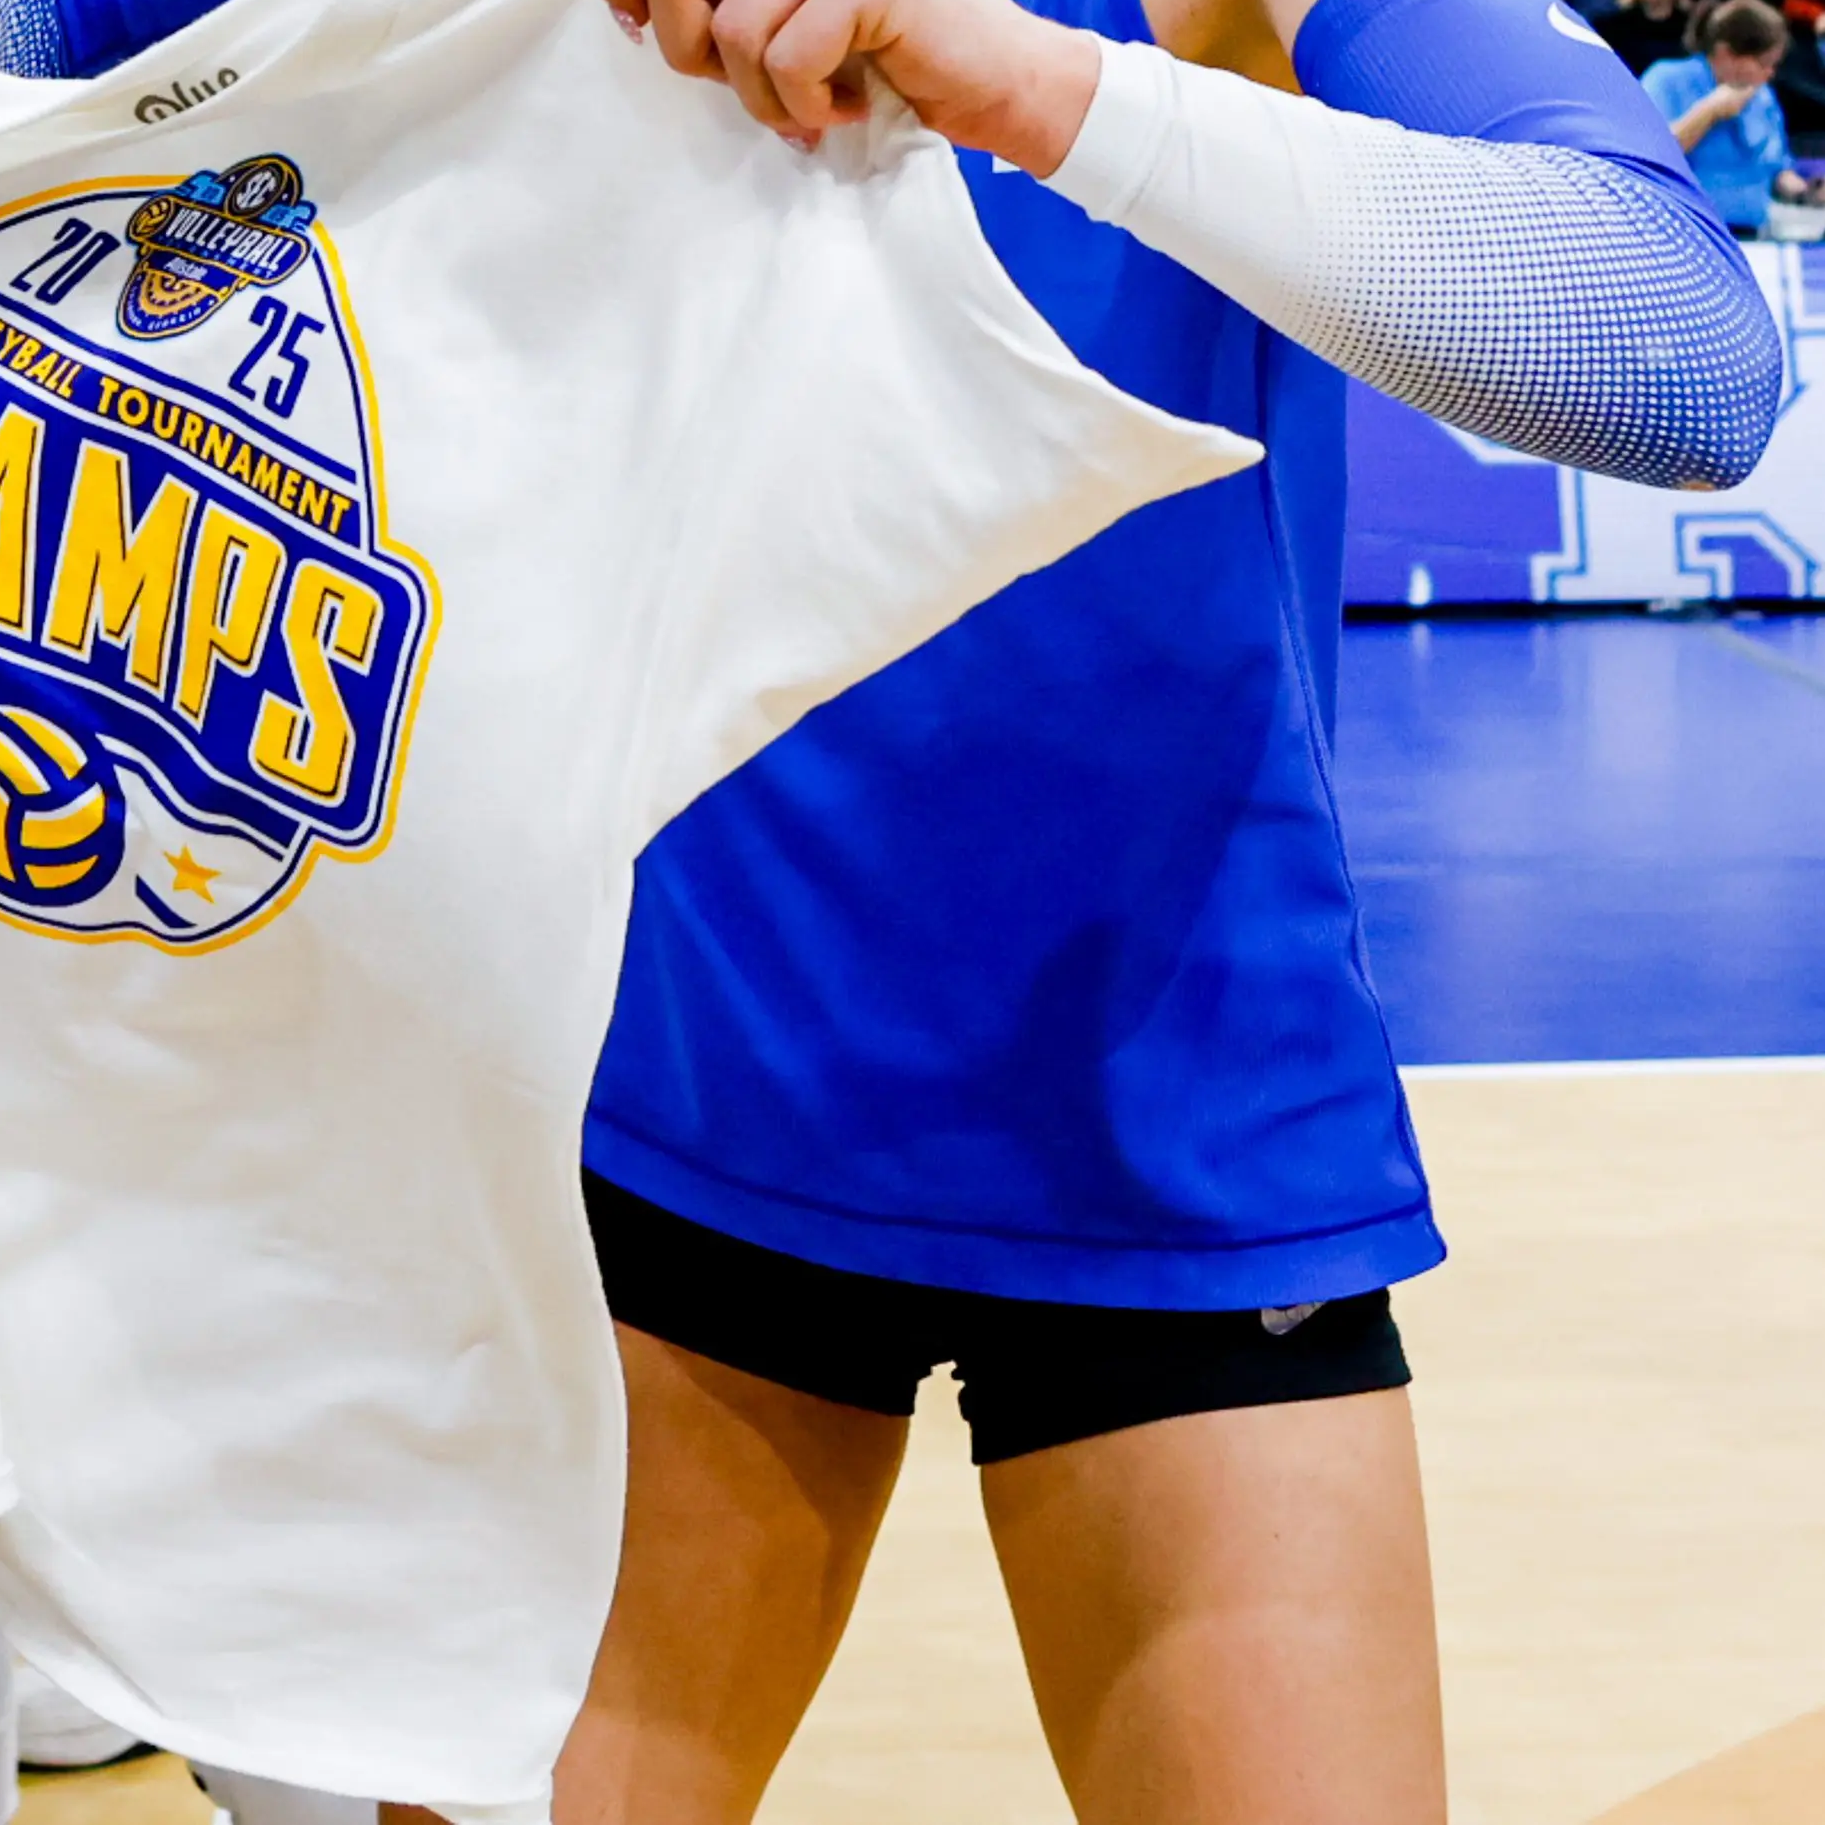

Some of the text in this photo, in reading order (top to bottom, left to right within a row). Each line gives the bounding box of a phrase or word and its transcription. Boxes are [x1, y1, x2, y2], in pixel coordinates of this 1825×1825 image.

[235, 170, 277, 211] SEC
[10, 216, 122, 307] 20
[165, 206, 296, 272] VOLLEYBALL
[227, 295, 326, 420] 25
[95, 372, 353, 534] TOURNAMENT
